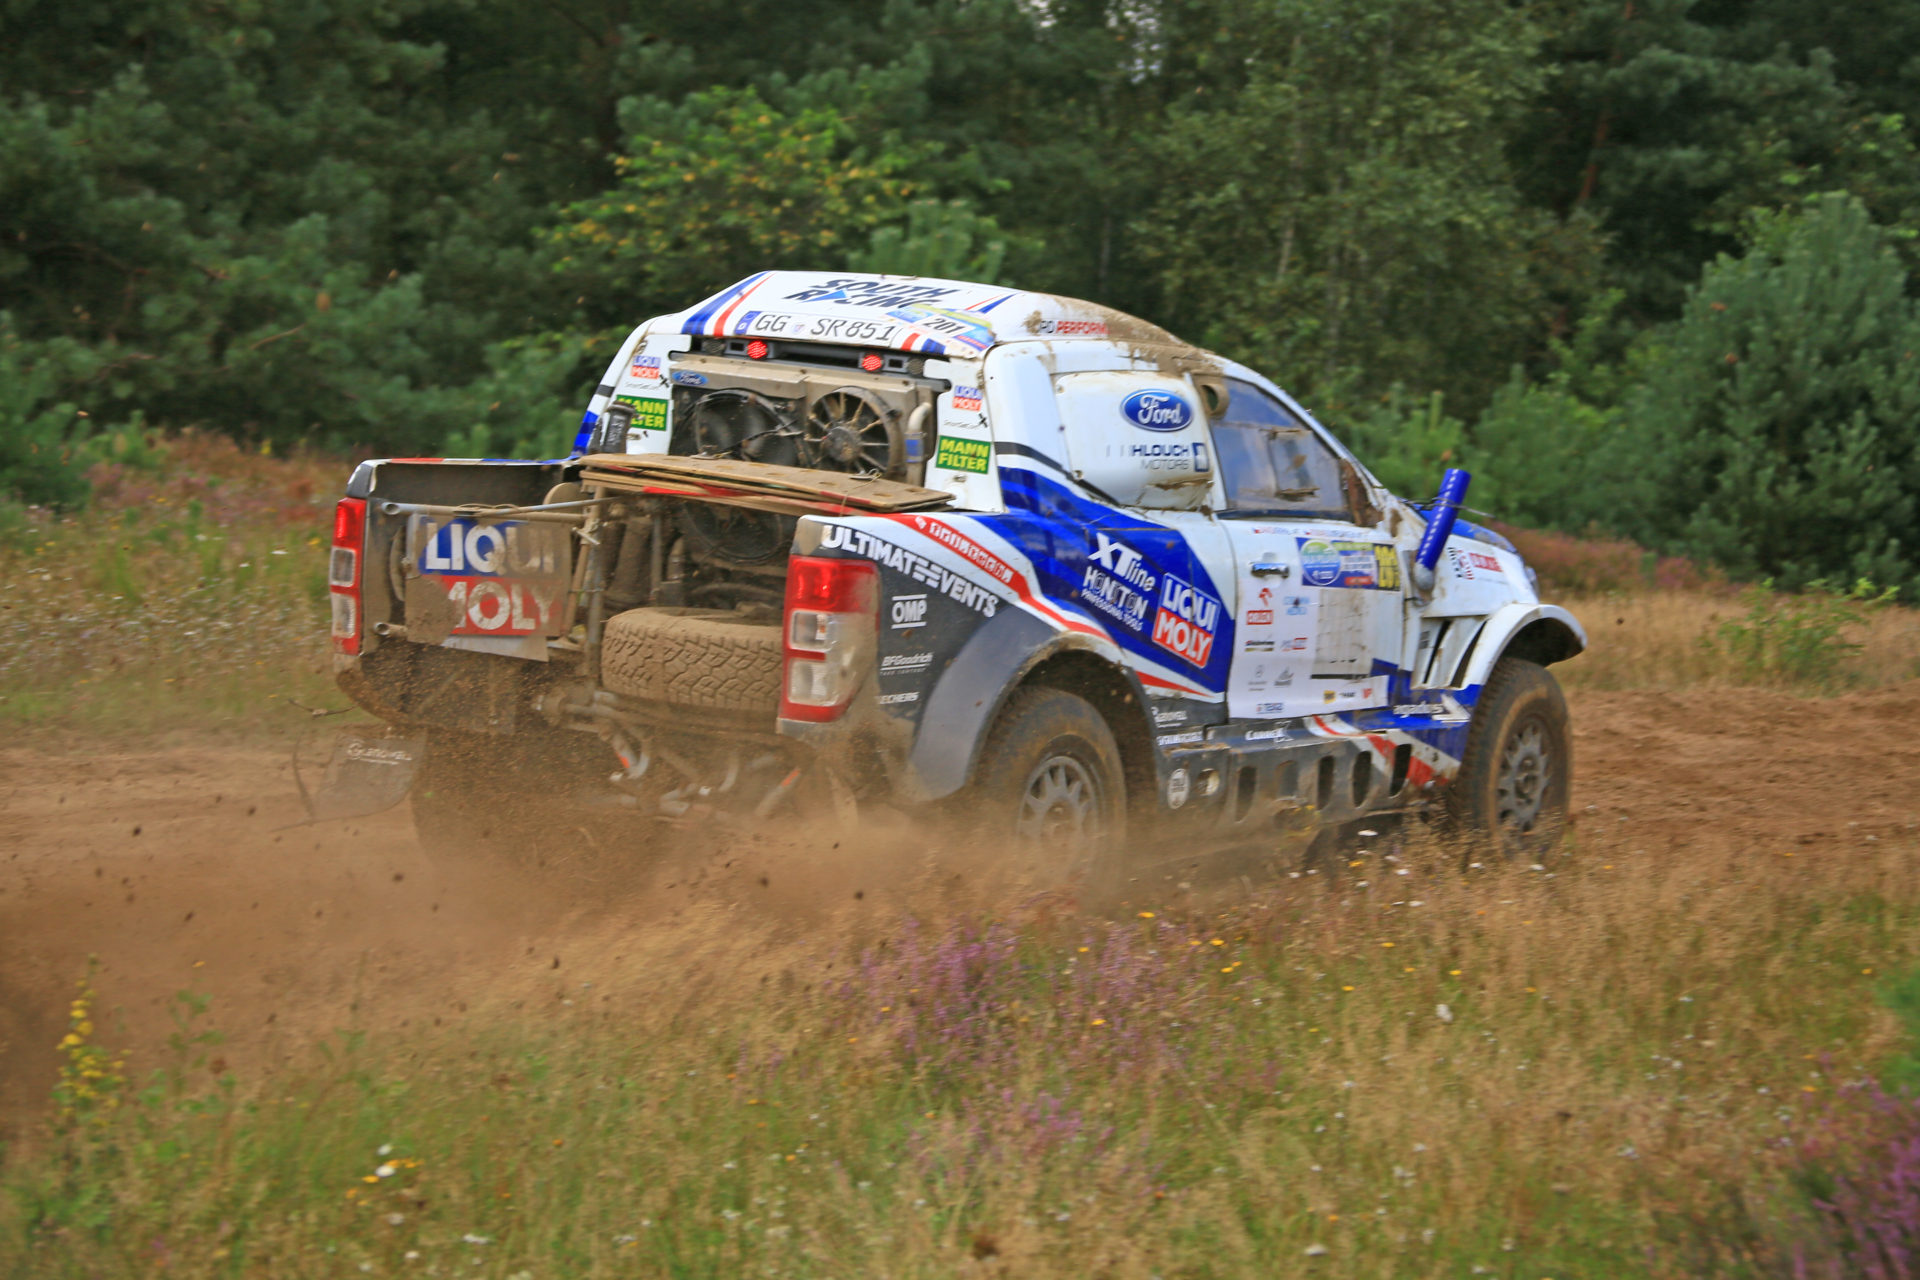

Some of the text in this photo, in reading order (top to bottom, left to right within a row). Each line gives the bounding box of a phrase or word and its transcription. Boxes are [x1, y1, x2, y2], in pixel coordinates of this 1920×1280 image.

[808, 279, 960, 299] SOUTH
[754, 314, 792, 333] GG
[924, 317, 969, 335] 201
[618, 398, 667, 415] ANN
[1137, 394, 1183, 424] Ford
[940, 438, 990, 457] MANN
[1132, 444, 1191, 457] HLOUCH
[938, 452, 988, 471] FILTER
[1141, 459, 1189, 470] MOTORS
[425, 522, 555, 576] LIQUI
[1088, 532, 1155, 592] XTline
[891, 600, 927, 624] OMP
[1161, 578, 1217, 631] LIQUI
[1156, 611, 1212, 662] MOLY
[881, 652, 934, 667] BFGoodrich
